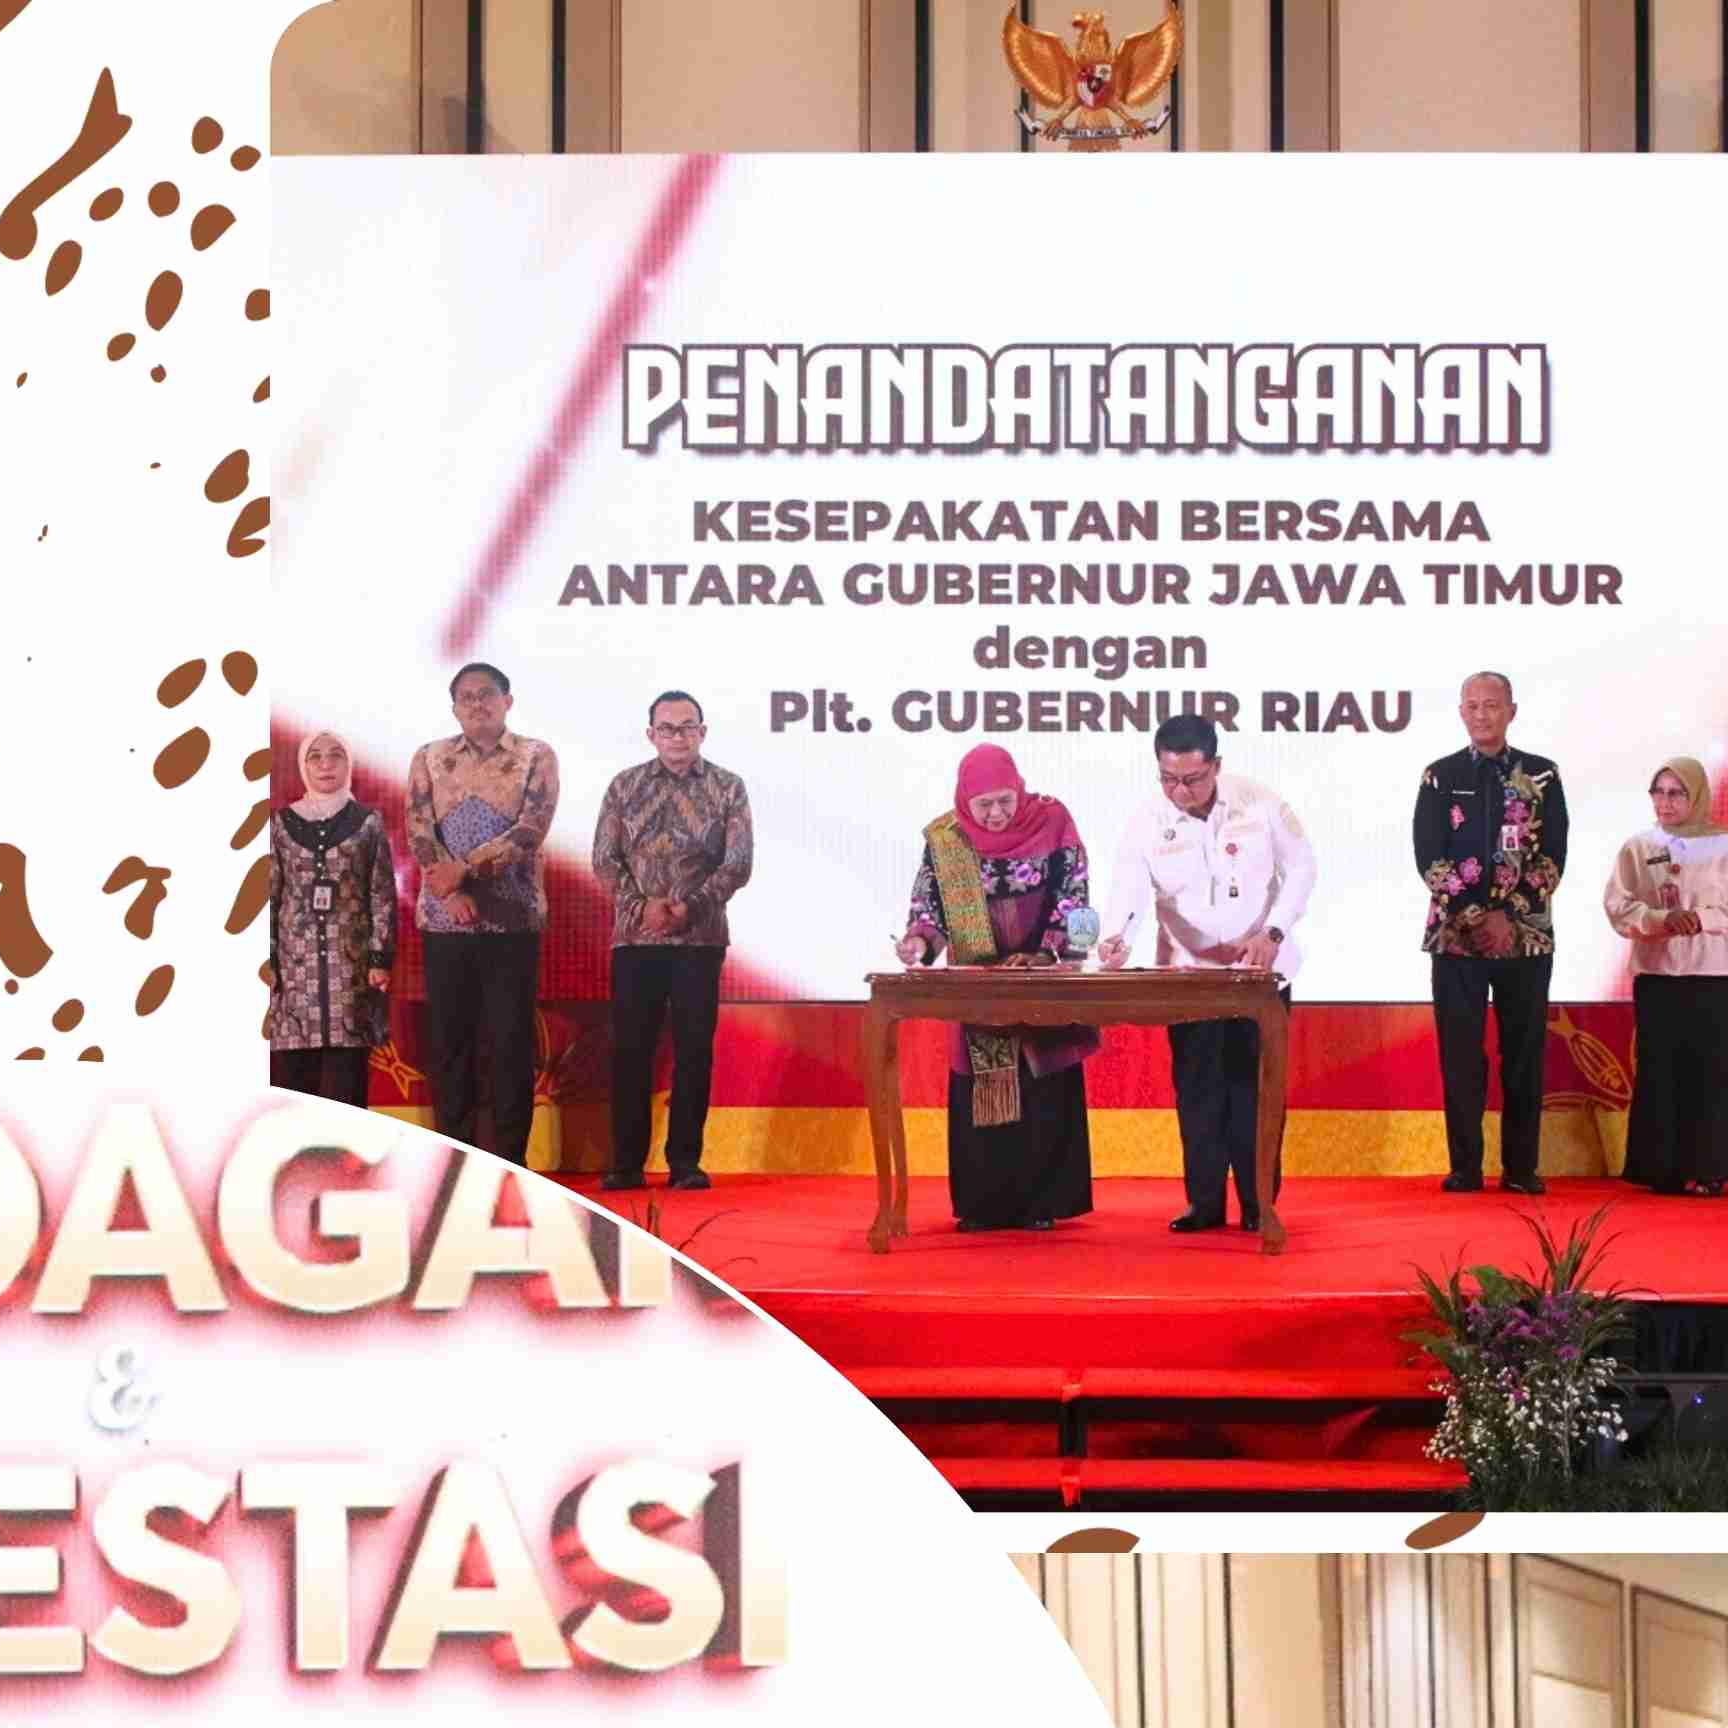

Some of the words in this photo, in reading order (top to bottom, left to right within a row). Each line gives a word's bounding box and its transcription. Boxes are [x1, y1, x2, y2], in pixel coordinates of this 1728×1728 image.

[622, 343, 1553, 456] PENANDATANGANAN
[693, 498, 1159, 543] KESEPAKATAN
[1180, 498, 1492, 543] BERSAMA
[558, 563, 825, 607] ANTARA
[842, 562, 1191, 606] GUBERNUR
[1208, 563, 1407, 606] JAWA
[1422, 563, 1623, 607] TIMUR
[972, 624, 1207, 681] dengan
[770, 688, 873, 734] Plt.
[891, 689, 1241, 734] GUBERNUR
[1261, 690, 1412, 734] RIAU
[91, 1344, 162, 1431] &
